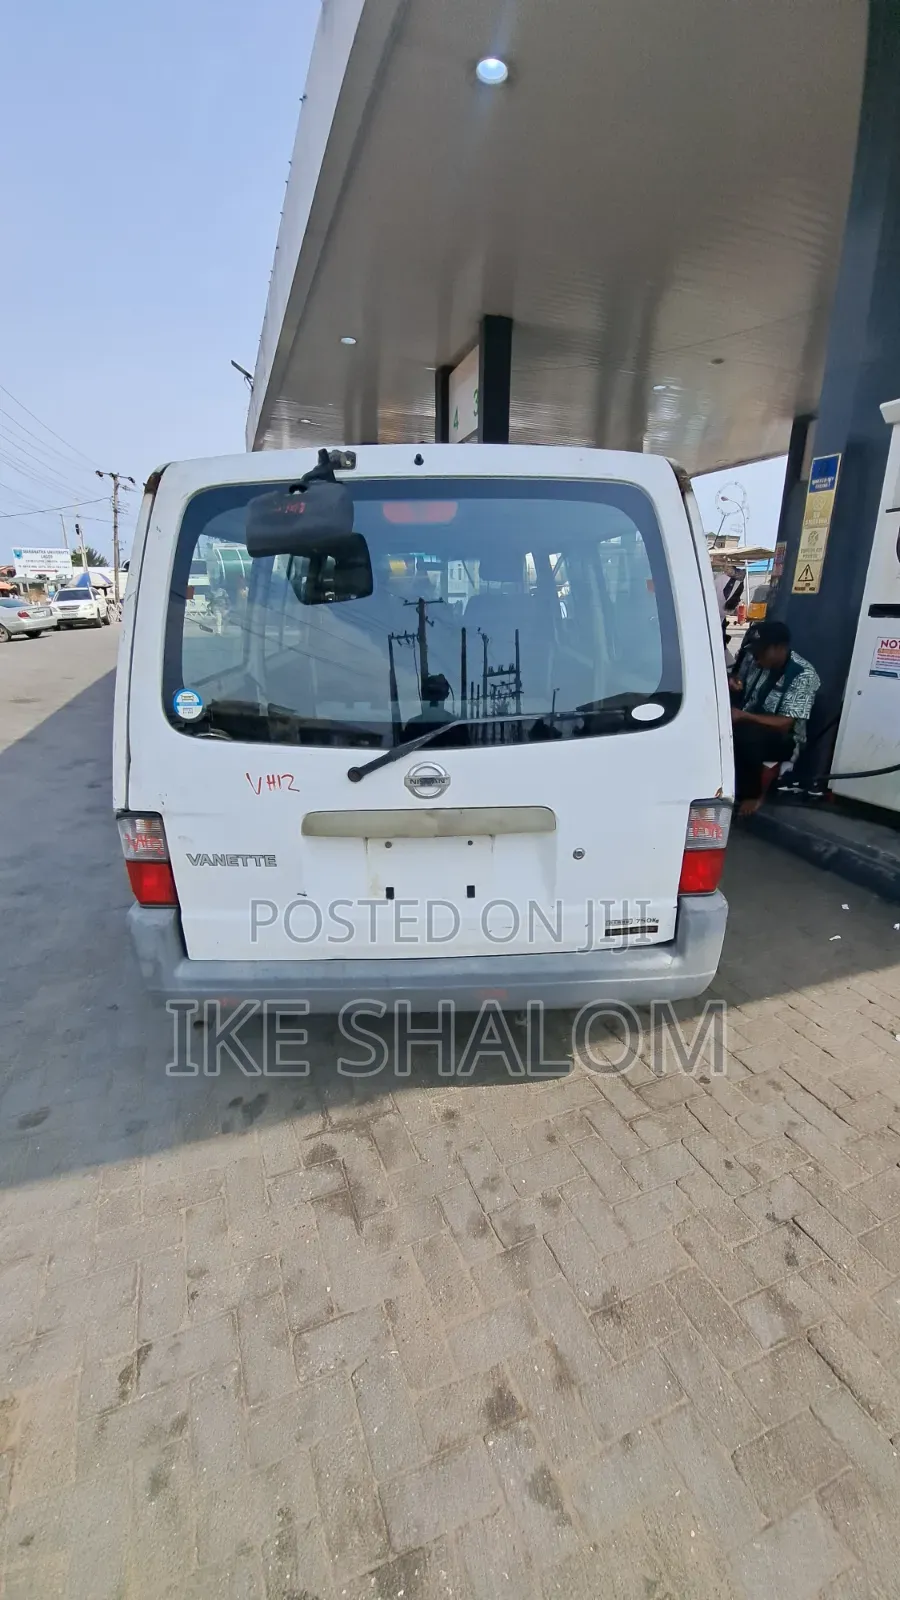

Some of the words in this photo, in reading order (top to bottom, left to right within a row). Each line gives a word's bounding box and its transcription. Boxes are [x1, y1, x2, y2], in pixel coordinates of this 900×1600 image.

[880, 639, 900, 649] NO
[245, 772, 300, 795] VH12
[186, 853, 277, 867] VANETTE
